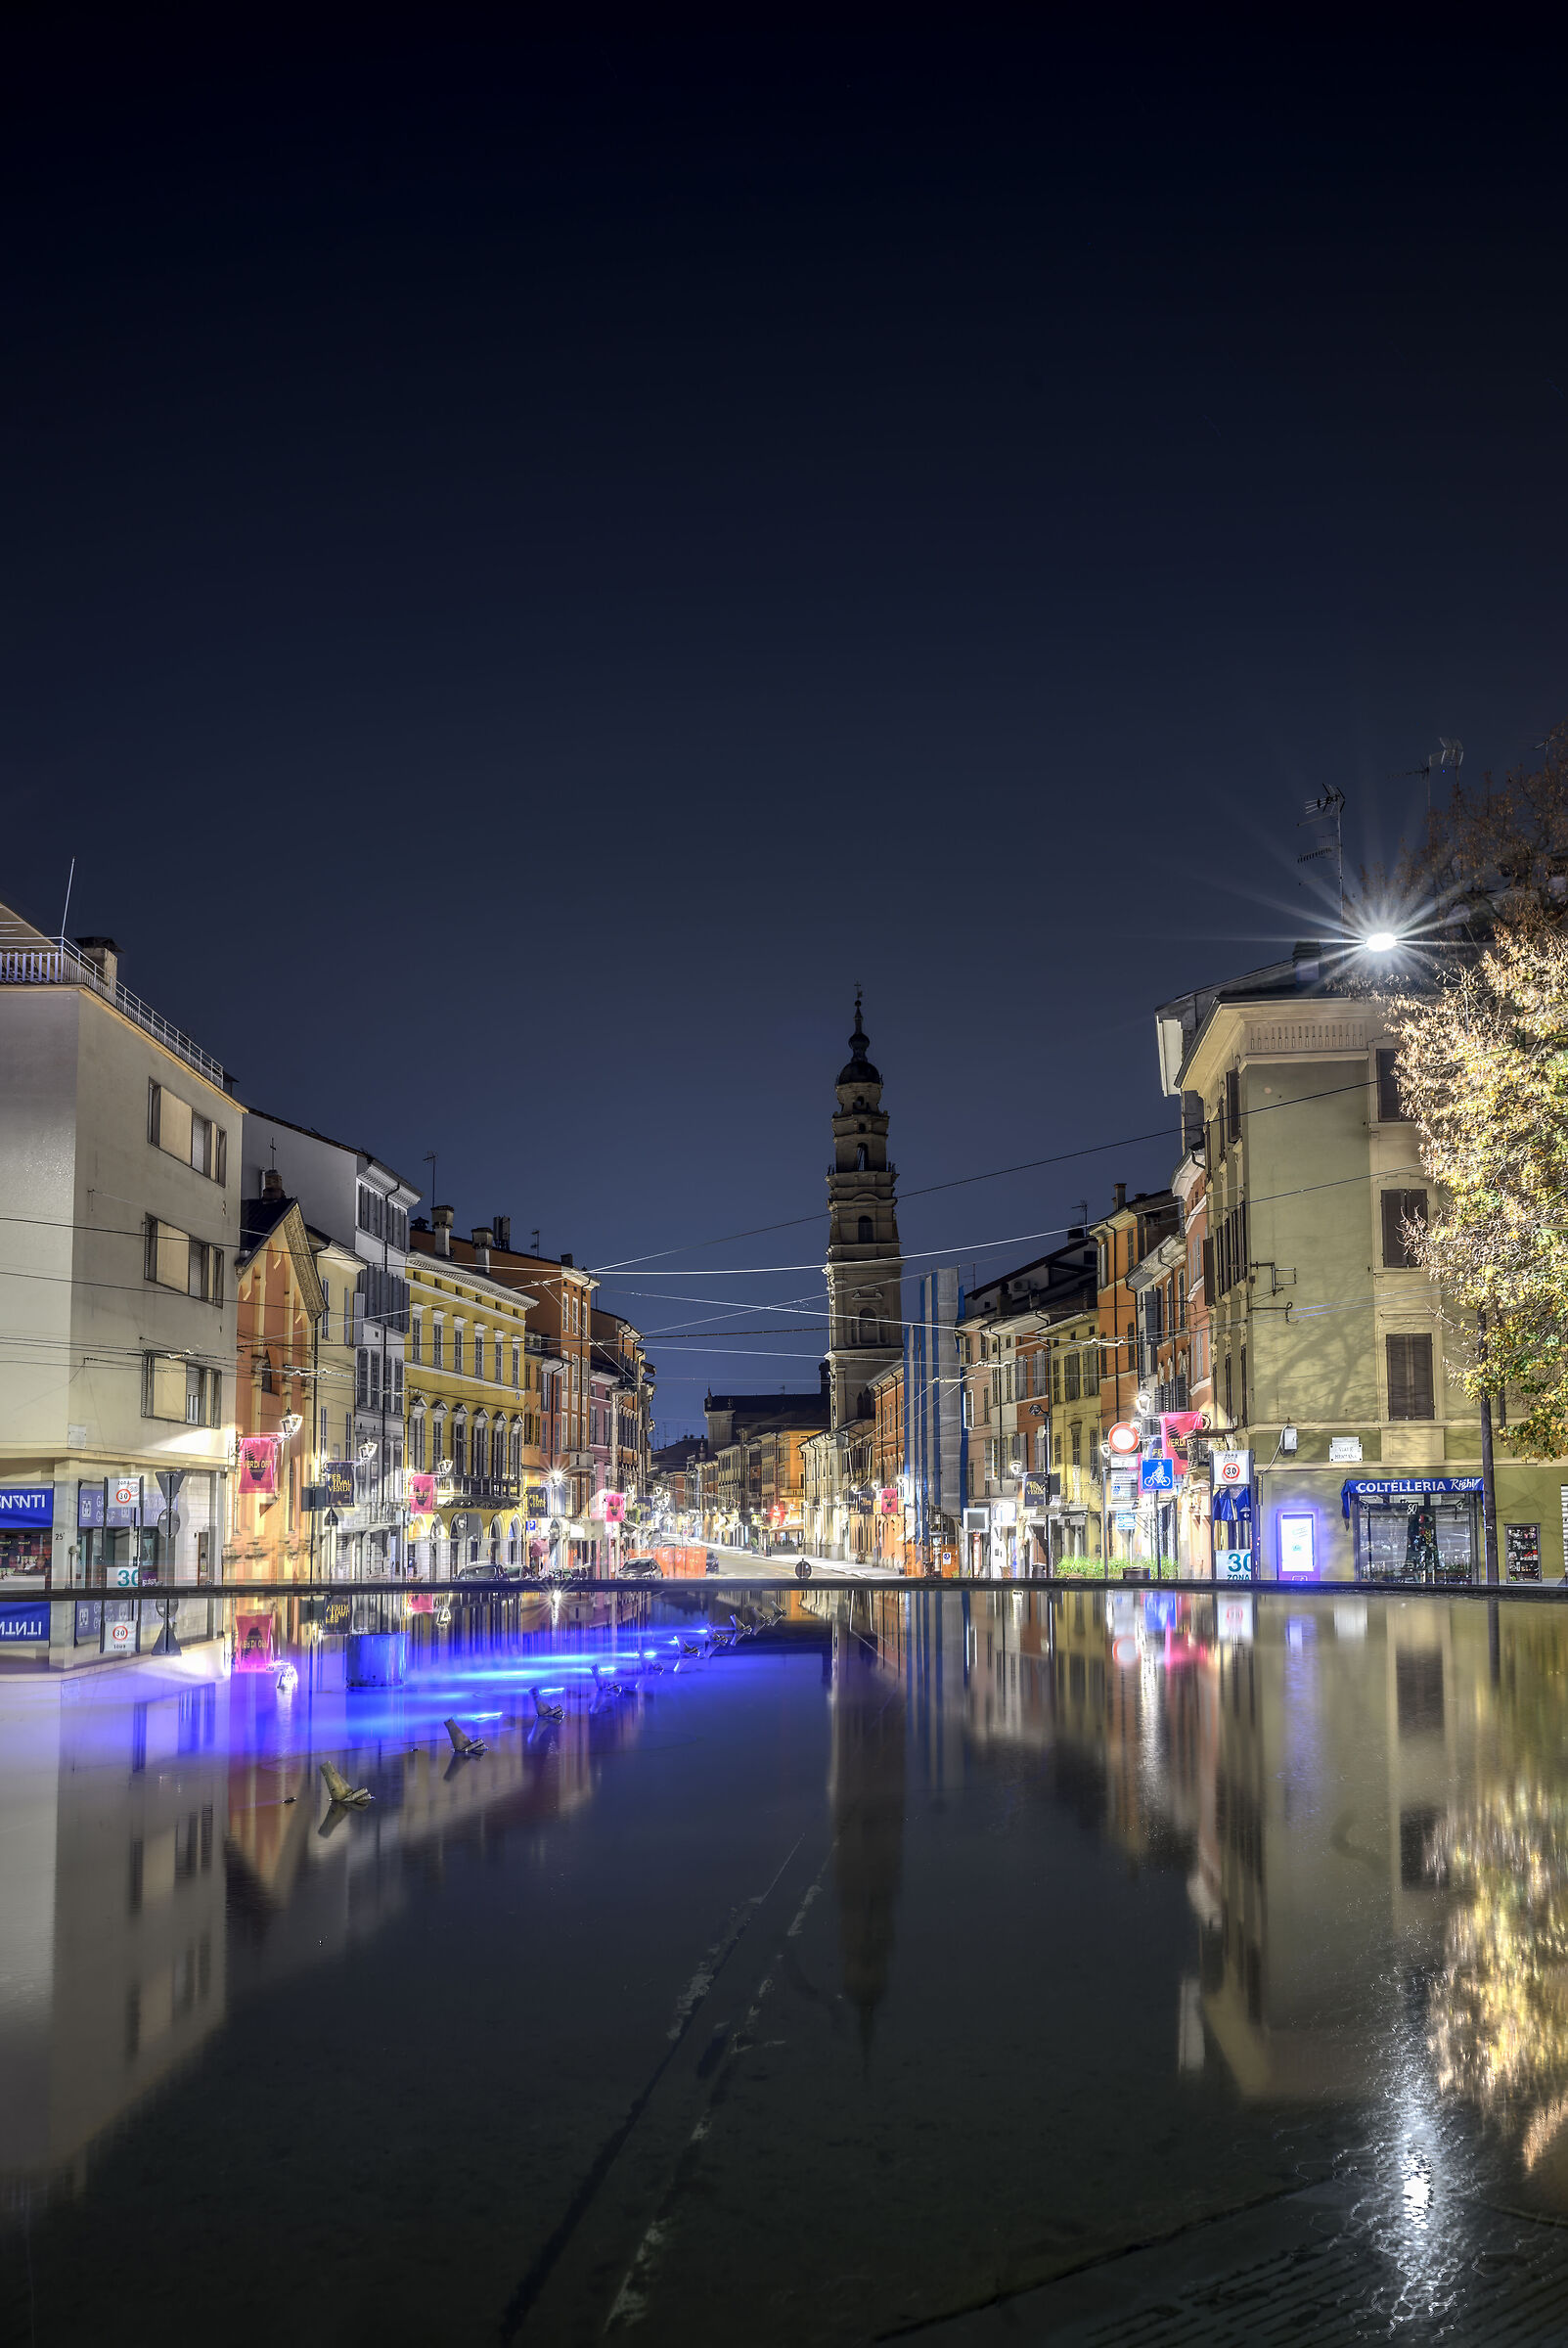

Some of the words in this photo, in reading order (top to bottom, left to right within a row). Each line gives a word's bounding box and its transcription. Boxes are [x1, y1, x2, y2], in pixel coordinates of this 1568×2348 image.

[1356, 1480, 1447, 1493] COLTELLERIA
[1228, 1553, 1252, 1572] 30
[117, 1569, 138, 1587] 30
